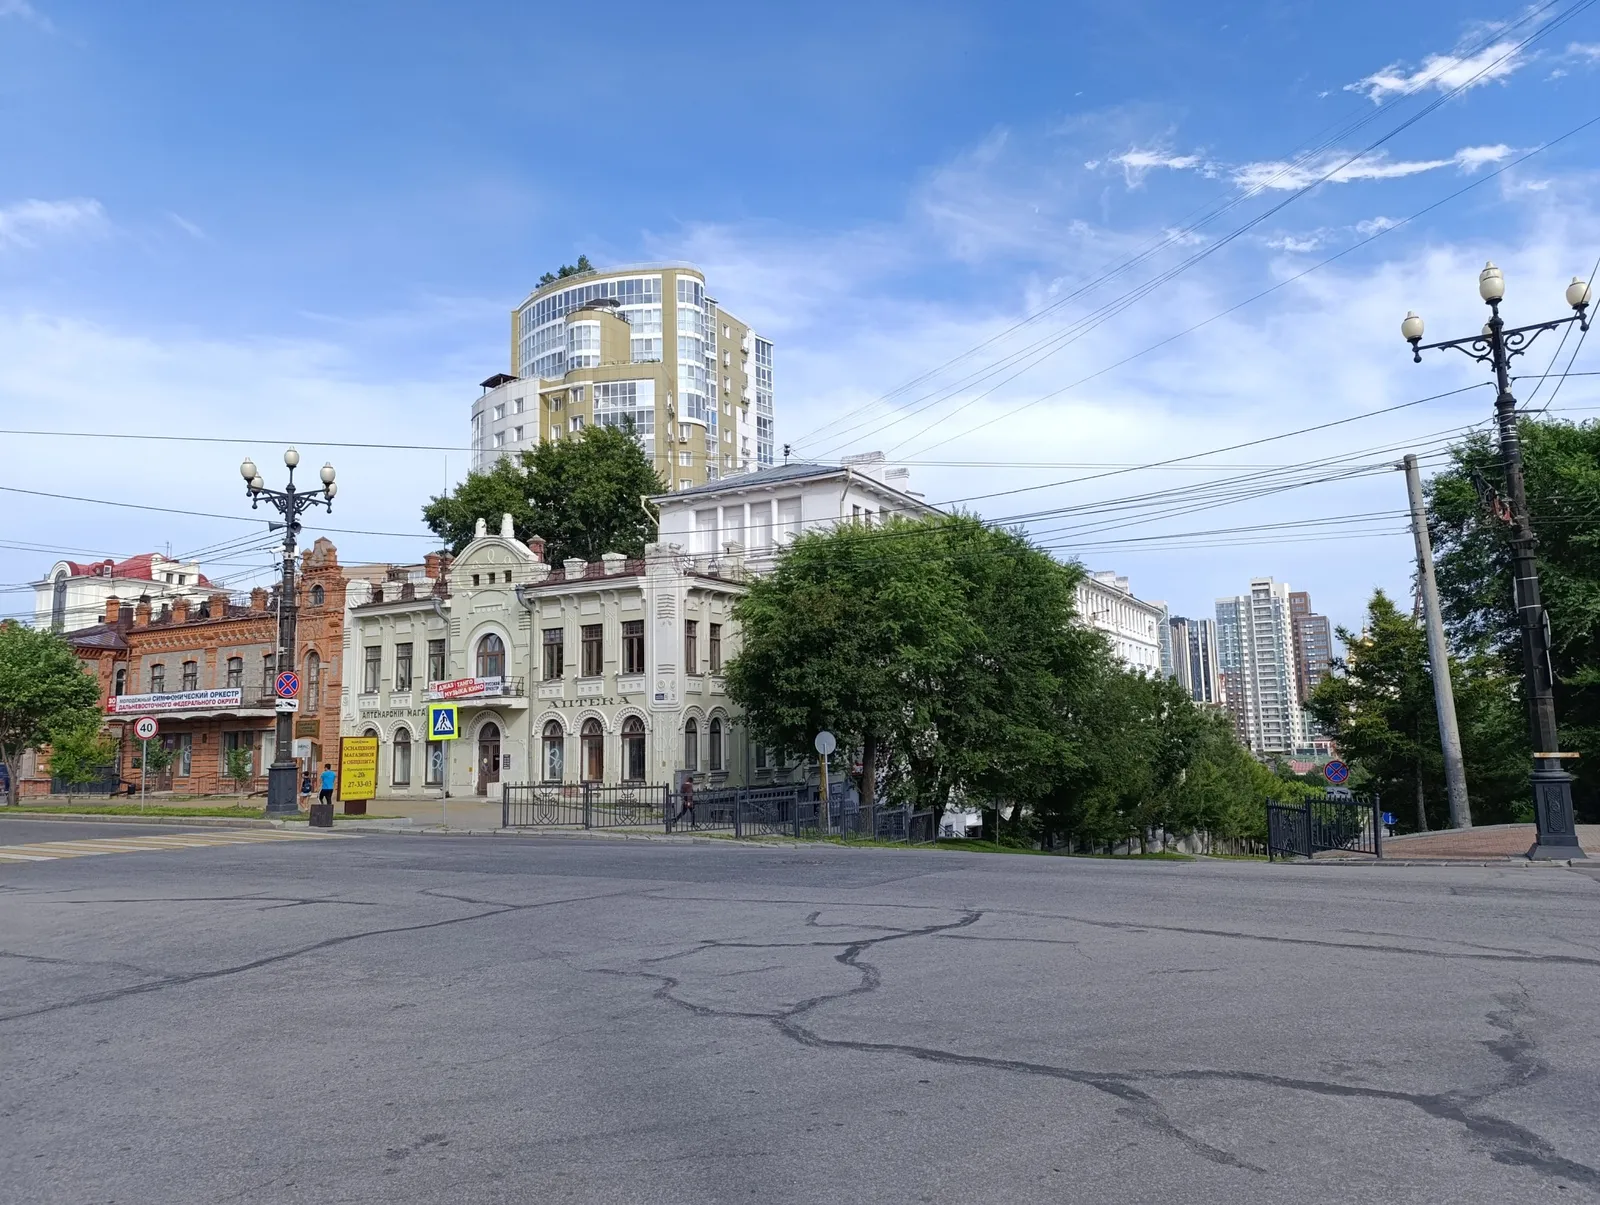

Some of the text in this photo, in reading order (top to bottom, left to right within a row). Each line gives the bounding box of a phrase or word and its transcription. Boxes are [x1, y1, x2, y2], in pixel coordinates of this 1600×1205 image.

[438, 679, 474, 691] ДЖАЗ ТАНГО
[444, 684, 484, 698] МУЗЫКА КИНО
[152, 691, 208, 702] СИМФОНИЧЕСКИЙ
[548, 696, 632, 709] АПТЕКА
[118, 702, 172, 711] ДАЛЬНЕВОСТОЧНОГО
[173, 699, 216, 707] ФЕДЕРАЛЬНОГО
[140, 724, 152, 732] 40
